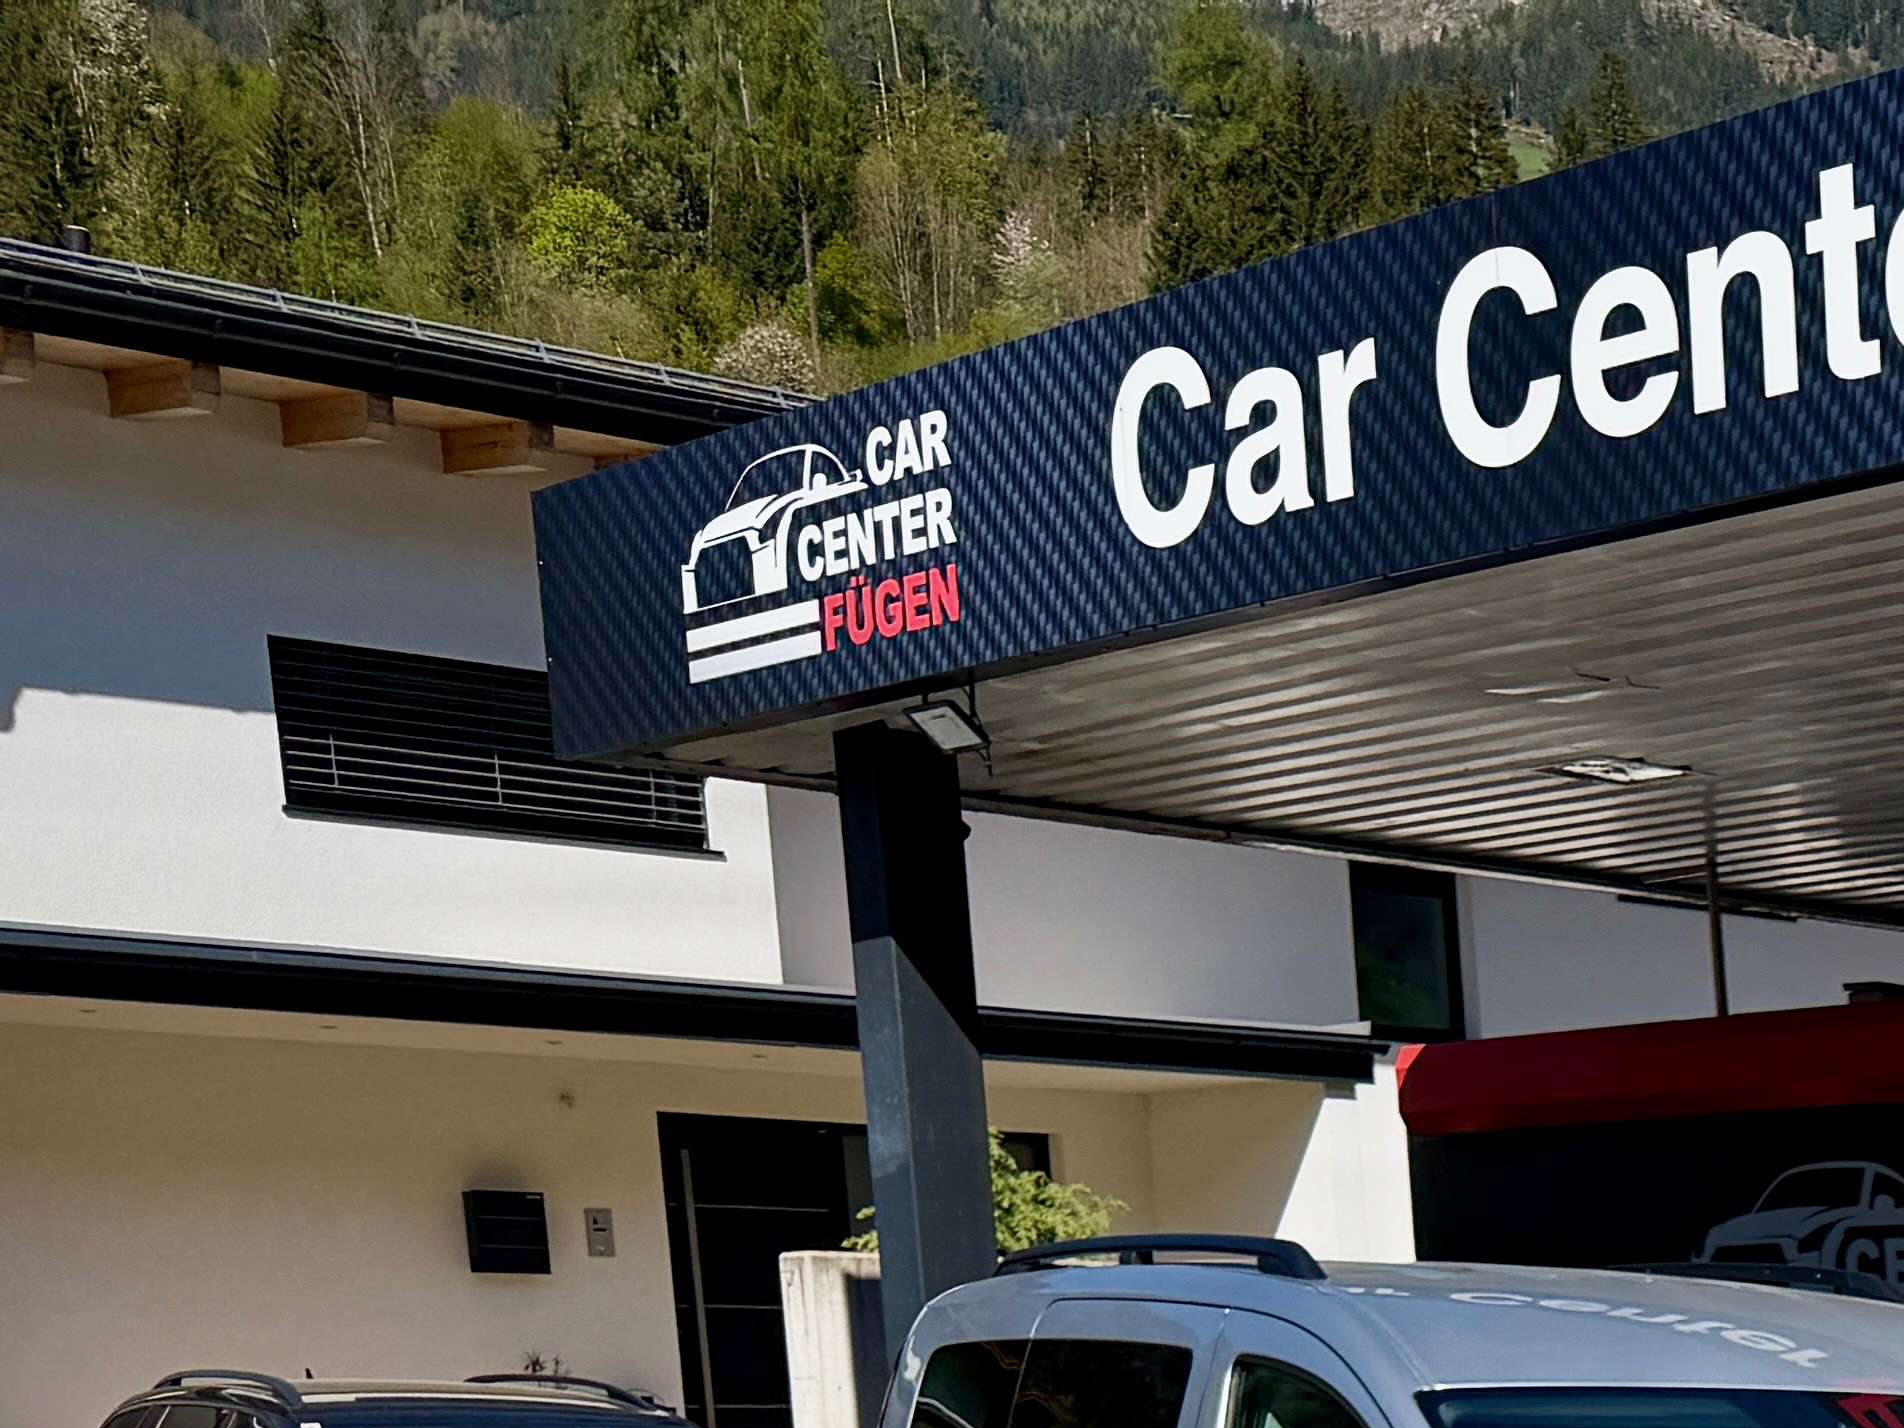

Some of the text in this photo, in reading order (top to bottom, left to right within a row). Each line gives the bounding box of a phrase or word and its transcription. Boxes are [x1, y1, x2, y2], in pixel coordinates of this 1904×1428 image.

[866, 409, 952, 486] CAR
[1110, 338, 1377, 549] Car
[797, 487, 957, 581] CENTER
[824, 563, 961, 652] FÜGEN
